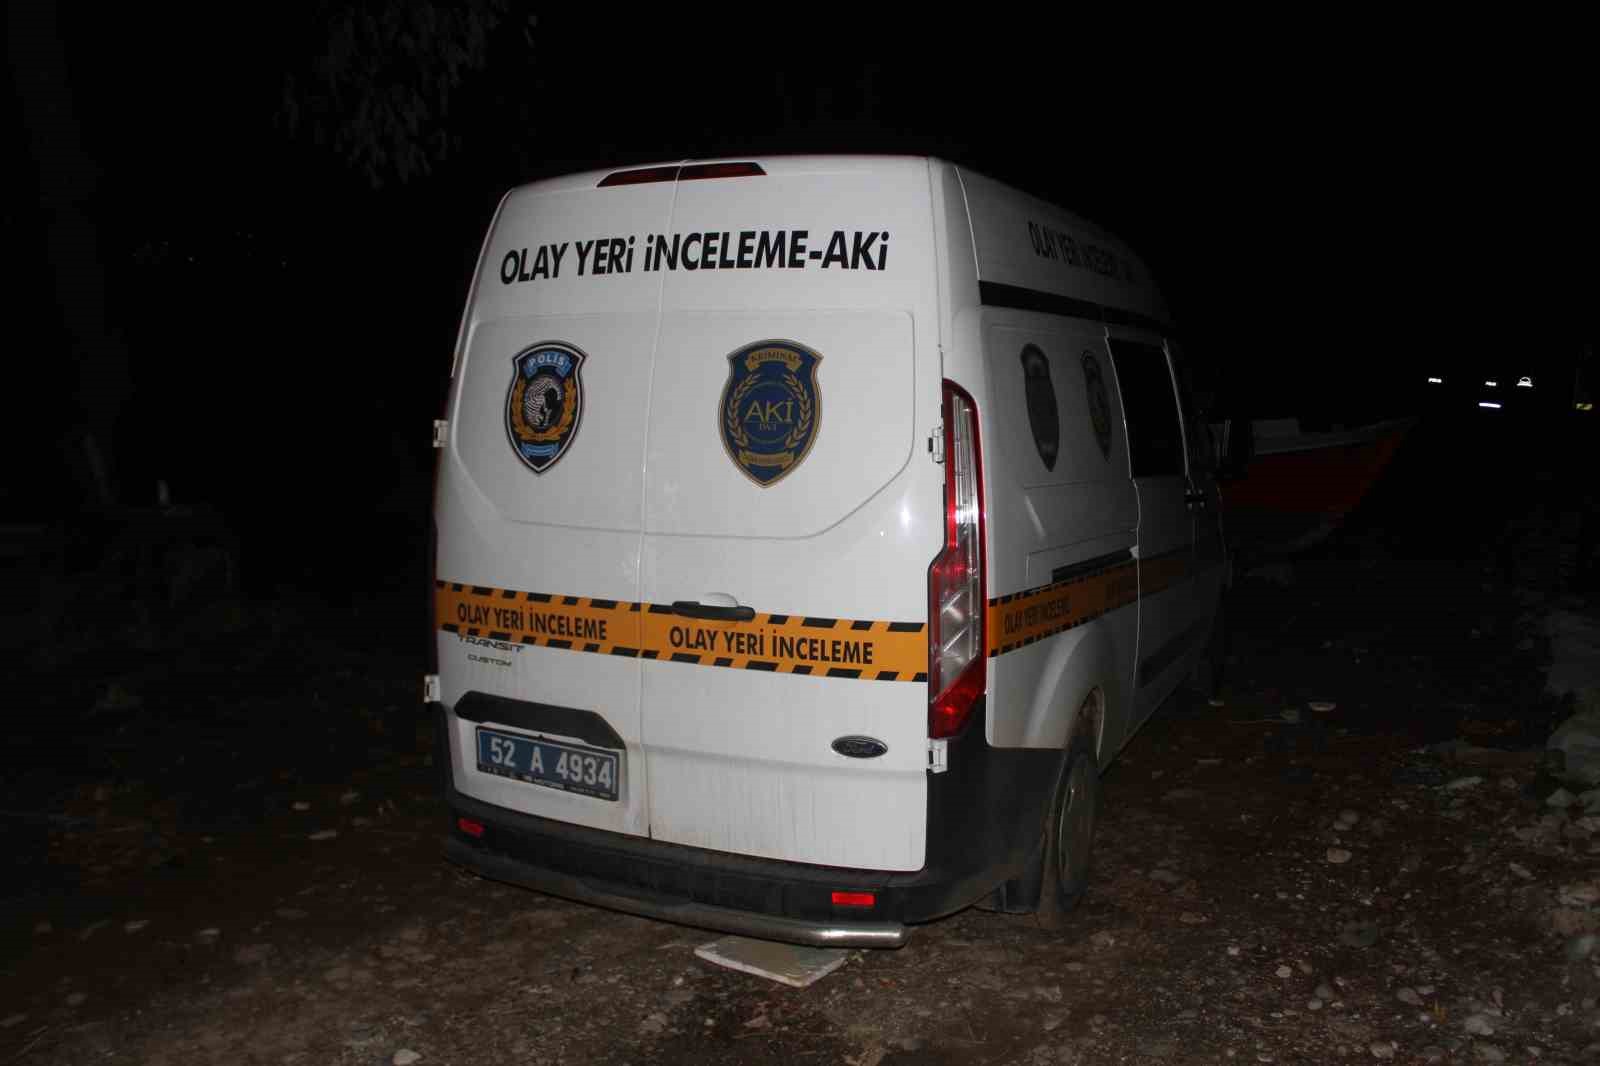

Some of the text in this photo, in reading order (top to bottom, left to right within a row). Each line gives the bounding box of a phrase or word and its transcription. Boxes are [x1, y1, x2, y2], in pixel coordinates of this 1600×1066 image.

[500, 242, 569, 285] OLAY
[457, 602, 607, 640] OLAY YERİ İNCELEME
[458, 633, 525, 652] TRANSIT
[669, 626, 873, 665] OLAY YERİ İNCELEME
[490, 737, 516, 767] 52
[530, 746, 545, 774] A
[555, 752, 612, 789] 4934
